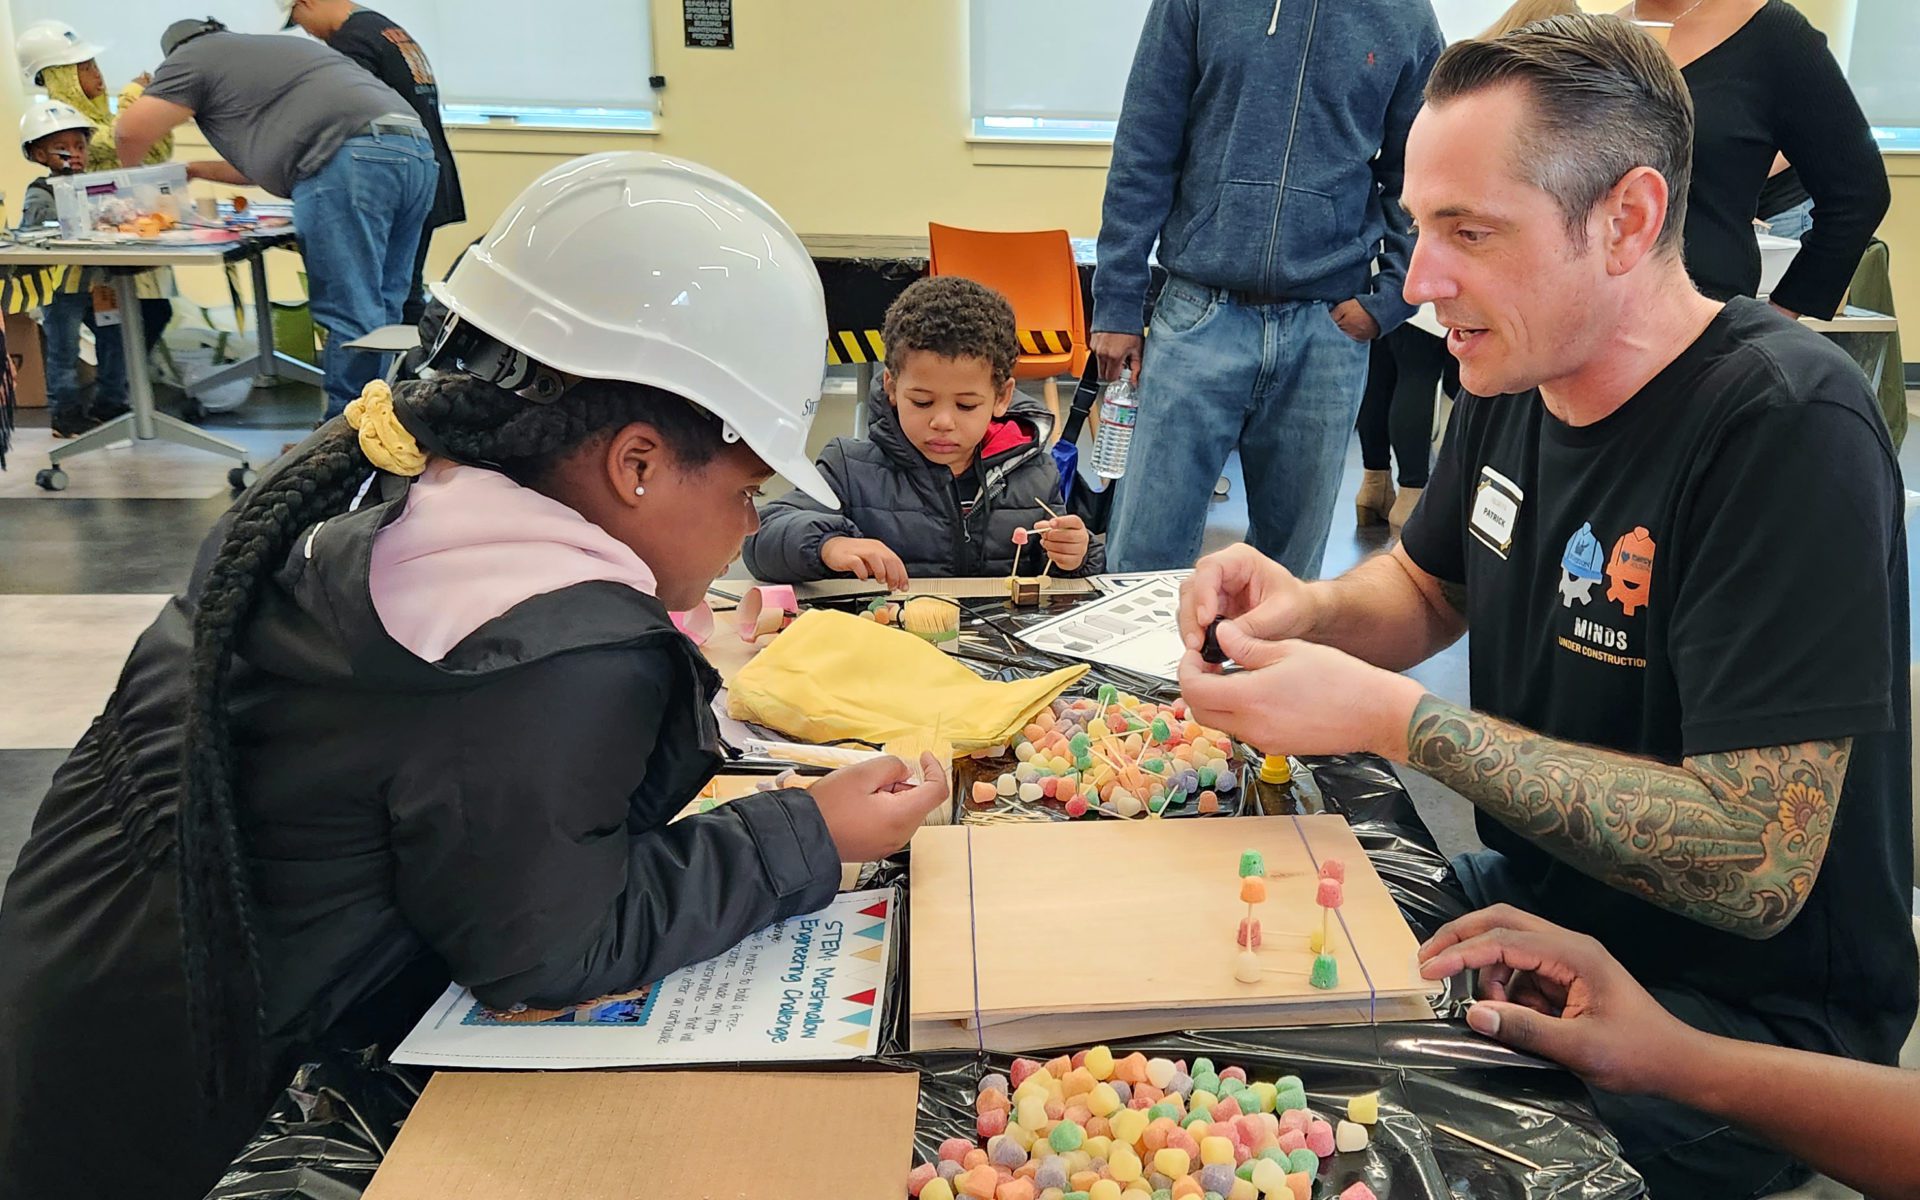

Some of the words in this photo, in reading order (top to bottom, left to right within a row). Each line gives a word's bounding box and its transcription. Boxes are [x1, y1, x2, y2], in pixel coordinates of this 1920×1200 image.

[1482, 507, 1506, 528] PATRICK
[1573, 616, 1628, 651] MINDS
[1558, 635, 1581, 653] UNDER
[817, 920, 844, 961] STEM:
[780, 918, 821, 983] Engineering
[742, 953, 759, 976] minutes
[678, 977, 696, 995] after
[714, 982, 731, 1000] made
[733, 987, 752, 1002] build
[672, 997, 685, 1007] an
[704, 1002, 724, 1016] only
[800, 967, 836, 1039] Marshmallow
[684, 1016, 702, 1030] that
[766, 989, 804, 1044] Challenge
[703, 1019, 722, 1034] from
